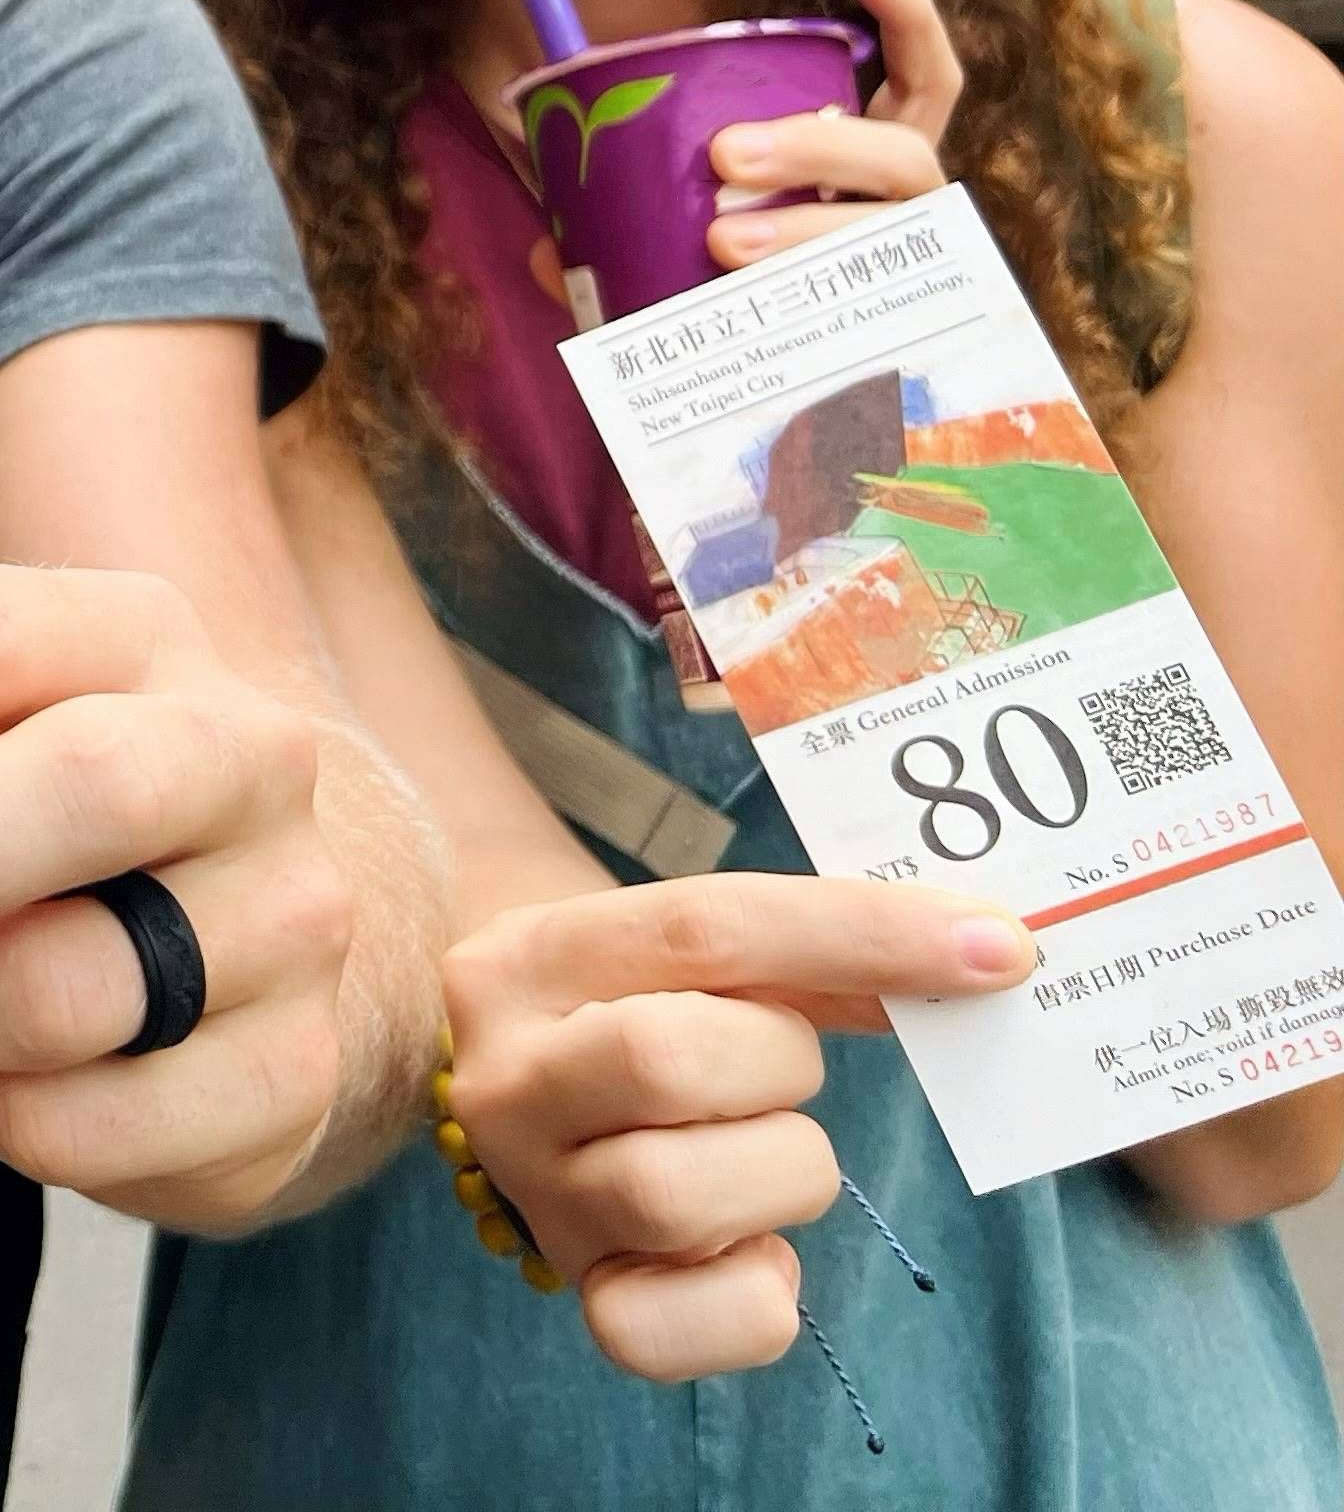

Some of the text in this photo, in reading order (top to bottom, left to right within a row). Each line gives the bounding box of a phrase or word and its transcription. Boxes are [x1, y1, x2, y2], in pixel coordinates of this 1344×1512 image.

[609, 227, 944, 381] 新北市立十三行博物館
[628, 272, 974, 413] Shihsanhang Museum of Archaeology,
[640, 371, 786, 436] New Taipei City
[800, 648, 1072, 759] 全票 General Admission
[864, 703, 1089, 884] NT$ 80
[1062, 792, 1276, 890] No. S 0421987
[1032, 953, 1146, 1012] 售票日期
[1145, 919, 1254, 969] Purchase
[1255, 899, 1320, 930] Date
[1093, 1005, 1233, 1074] 供一位入場
[1112, 1060, 1171, 1094] Admit
[1216, 1028, 1257, 1056] void
[1259, 1021, 1277, 1042] if
[1170, 1029, 1344, 1105] No. S 04219
